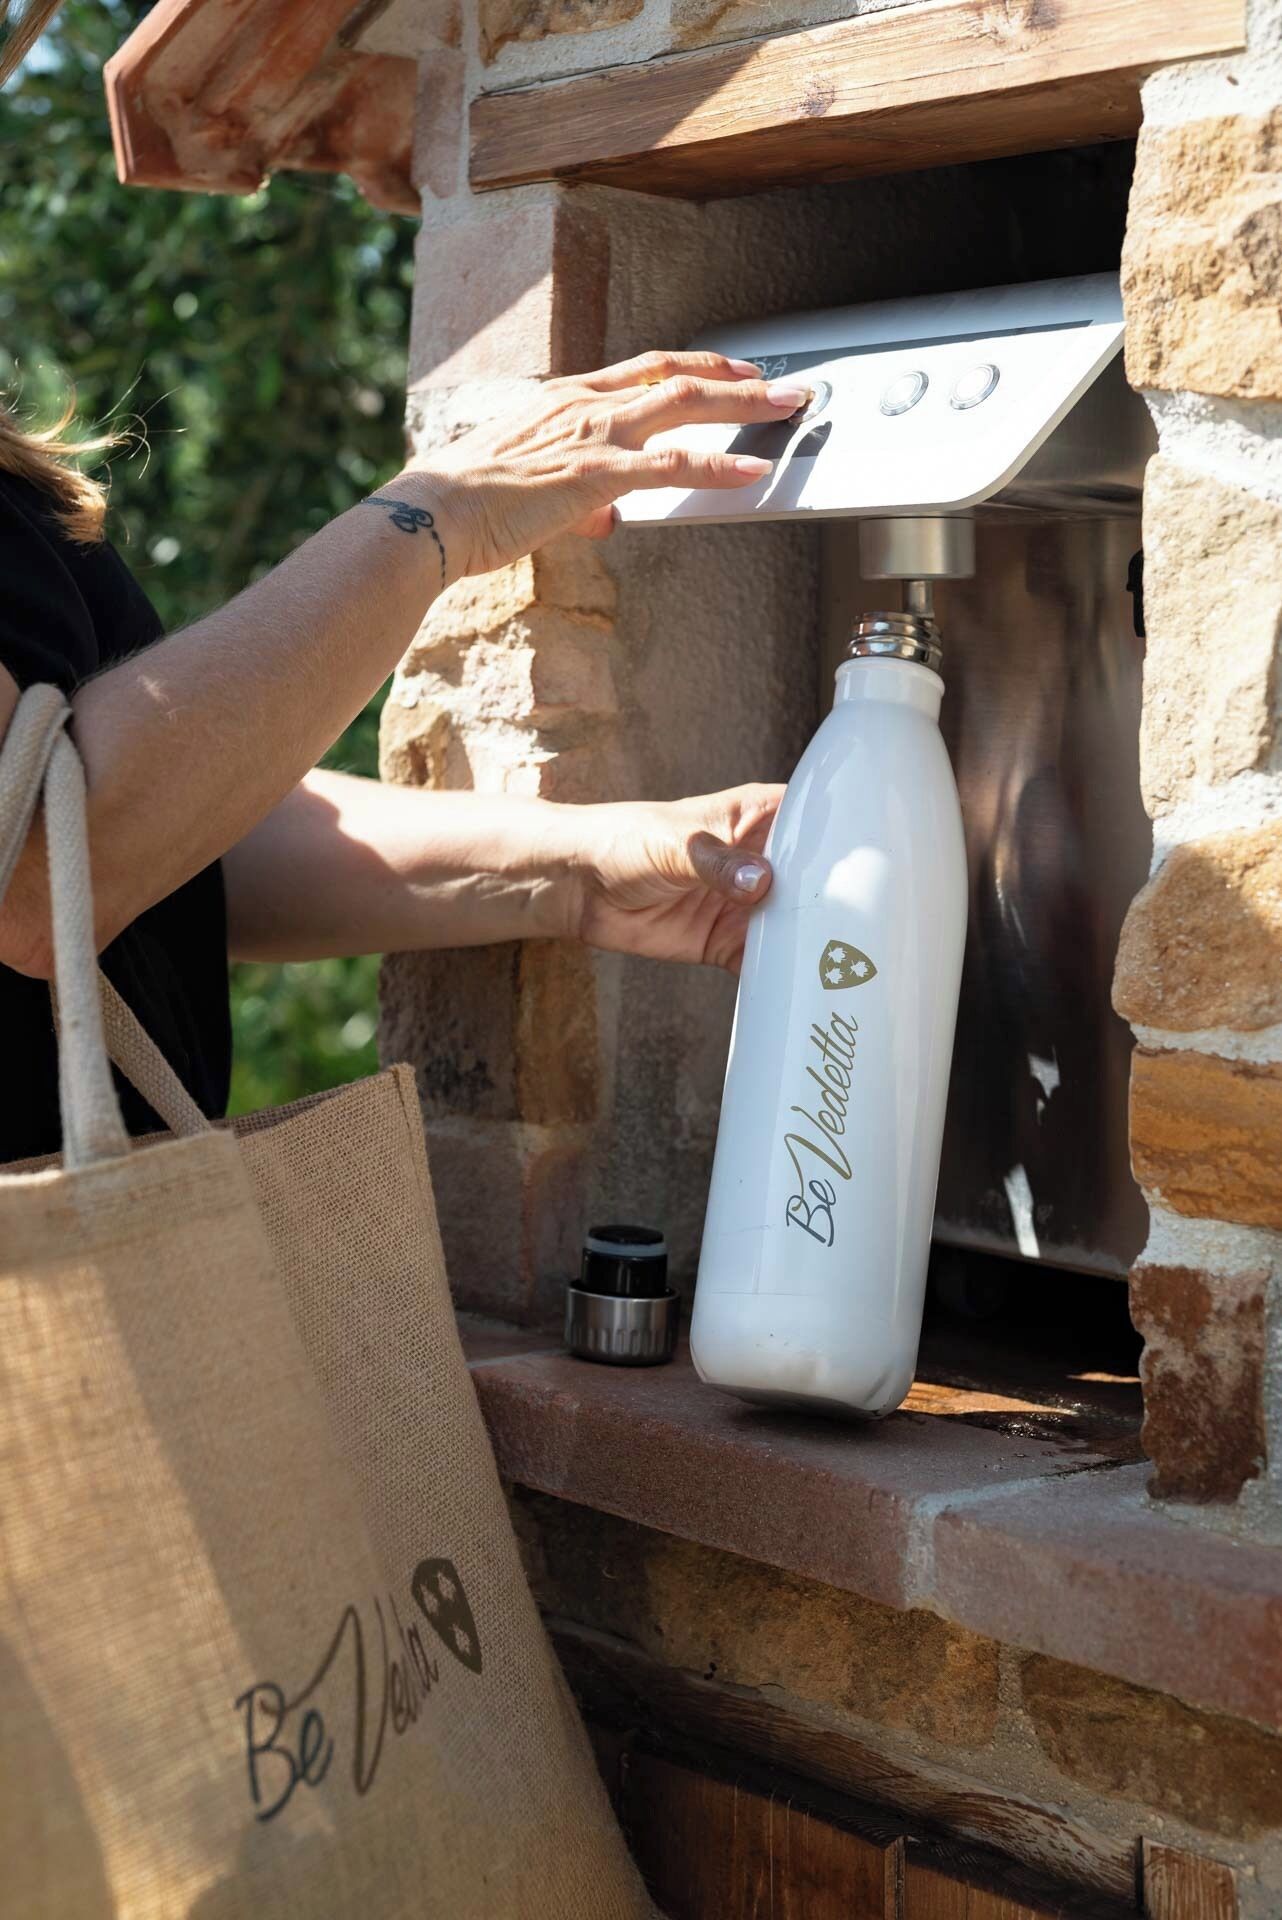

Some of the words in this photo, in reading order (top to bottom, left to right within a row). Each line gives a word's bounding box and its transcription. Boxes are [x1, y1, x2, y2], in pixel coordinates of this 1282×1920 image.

[785, 1012, 859, 1211] Vedetta
[786, 1179, 837, 1247] Be
[235, 1682, 333, 1821] Be
